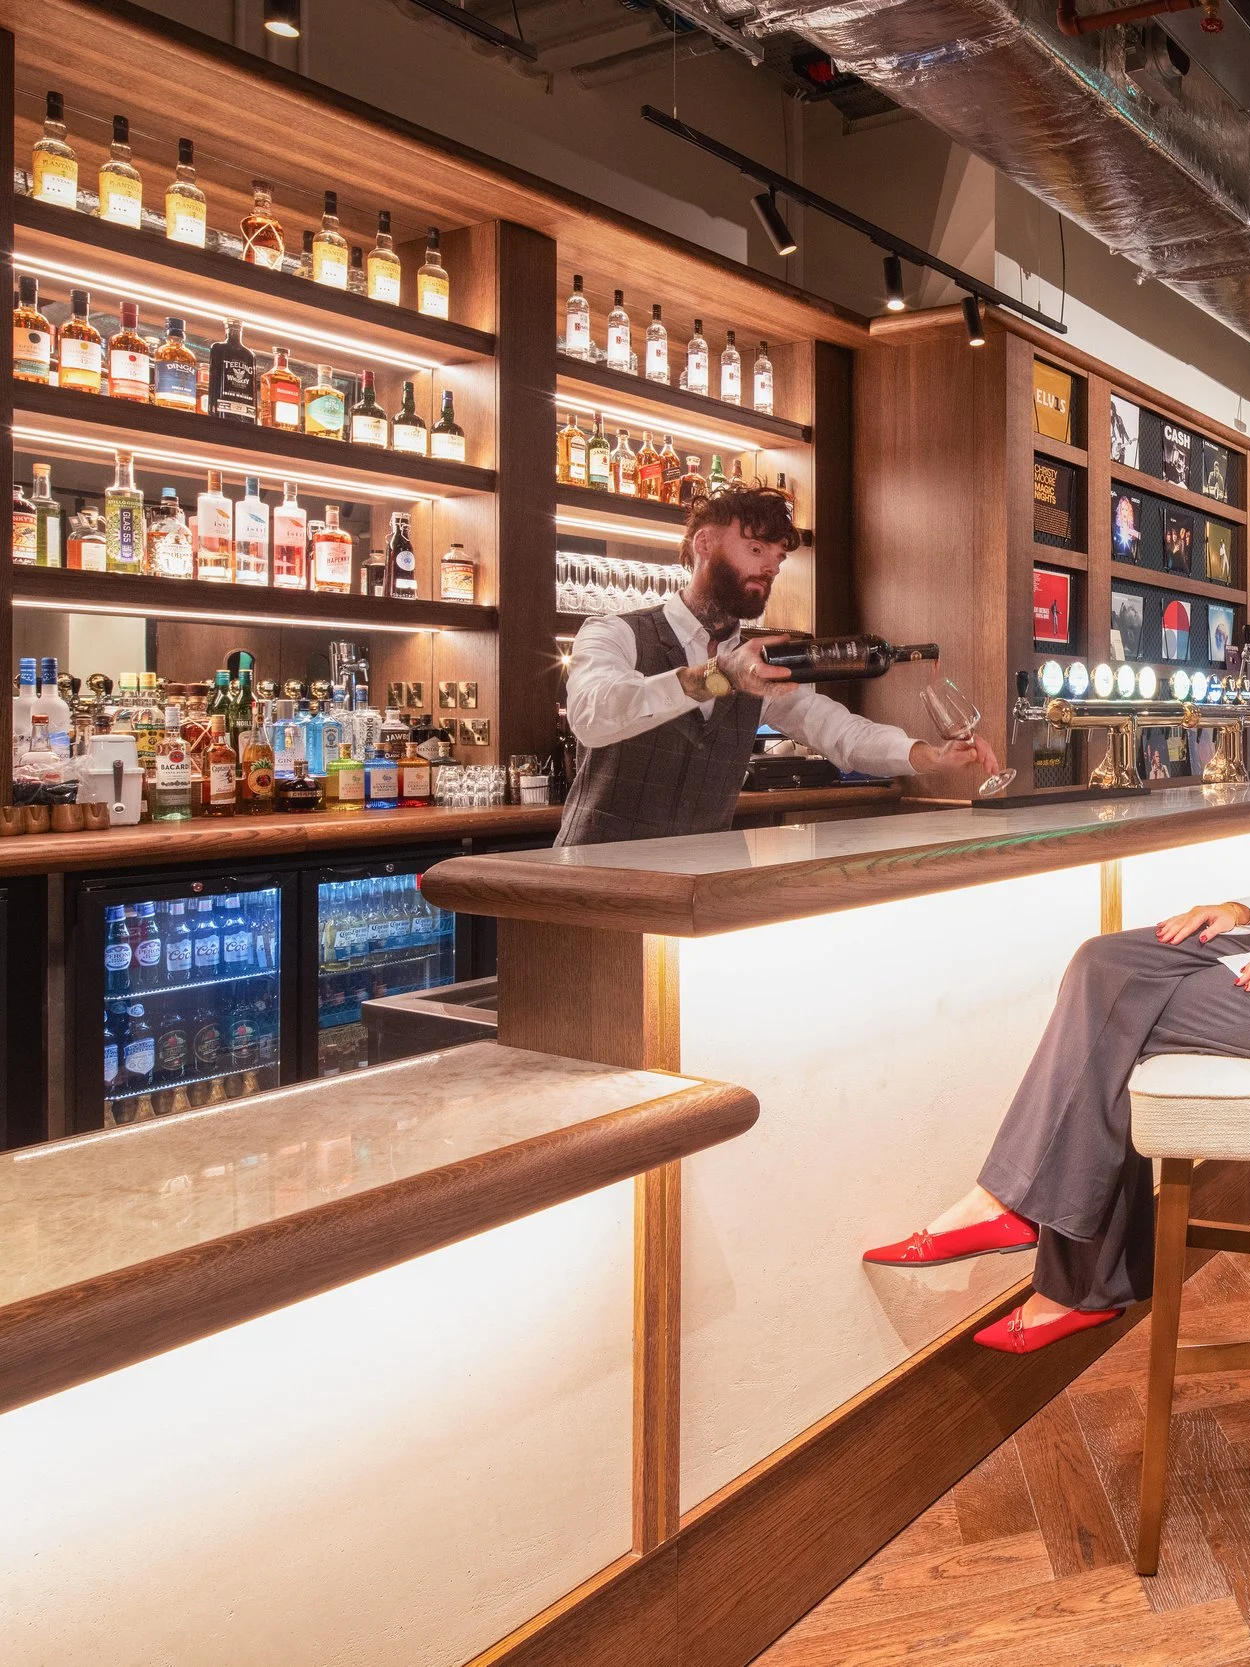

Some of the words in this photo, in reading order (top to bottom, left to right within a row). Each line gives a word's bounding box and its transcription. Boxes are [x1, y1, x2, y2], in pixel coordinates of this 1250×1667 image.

[223, 360, 253, 375] TEELING
[1164, 425, 1191, 450] CASH
[1034, 463, 1058, 479] CHRISTY
[1034, 471, 1056, 487] MOORE
[1034, 481, 1055, 496] MAGIC
[1034, 490, 1057, 505] NIGHTS
[122, 511, 131, 531] GLAS
[122, 532, 131, 543] 55
[366, 717, 374, 746] DINGLE
[211, 765, 230, 773] Captain
[196, 945, 219, 956] Coo
[225, 941, 247, 953] Coo
[168, 949, 191, 961] Coo
